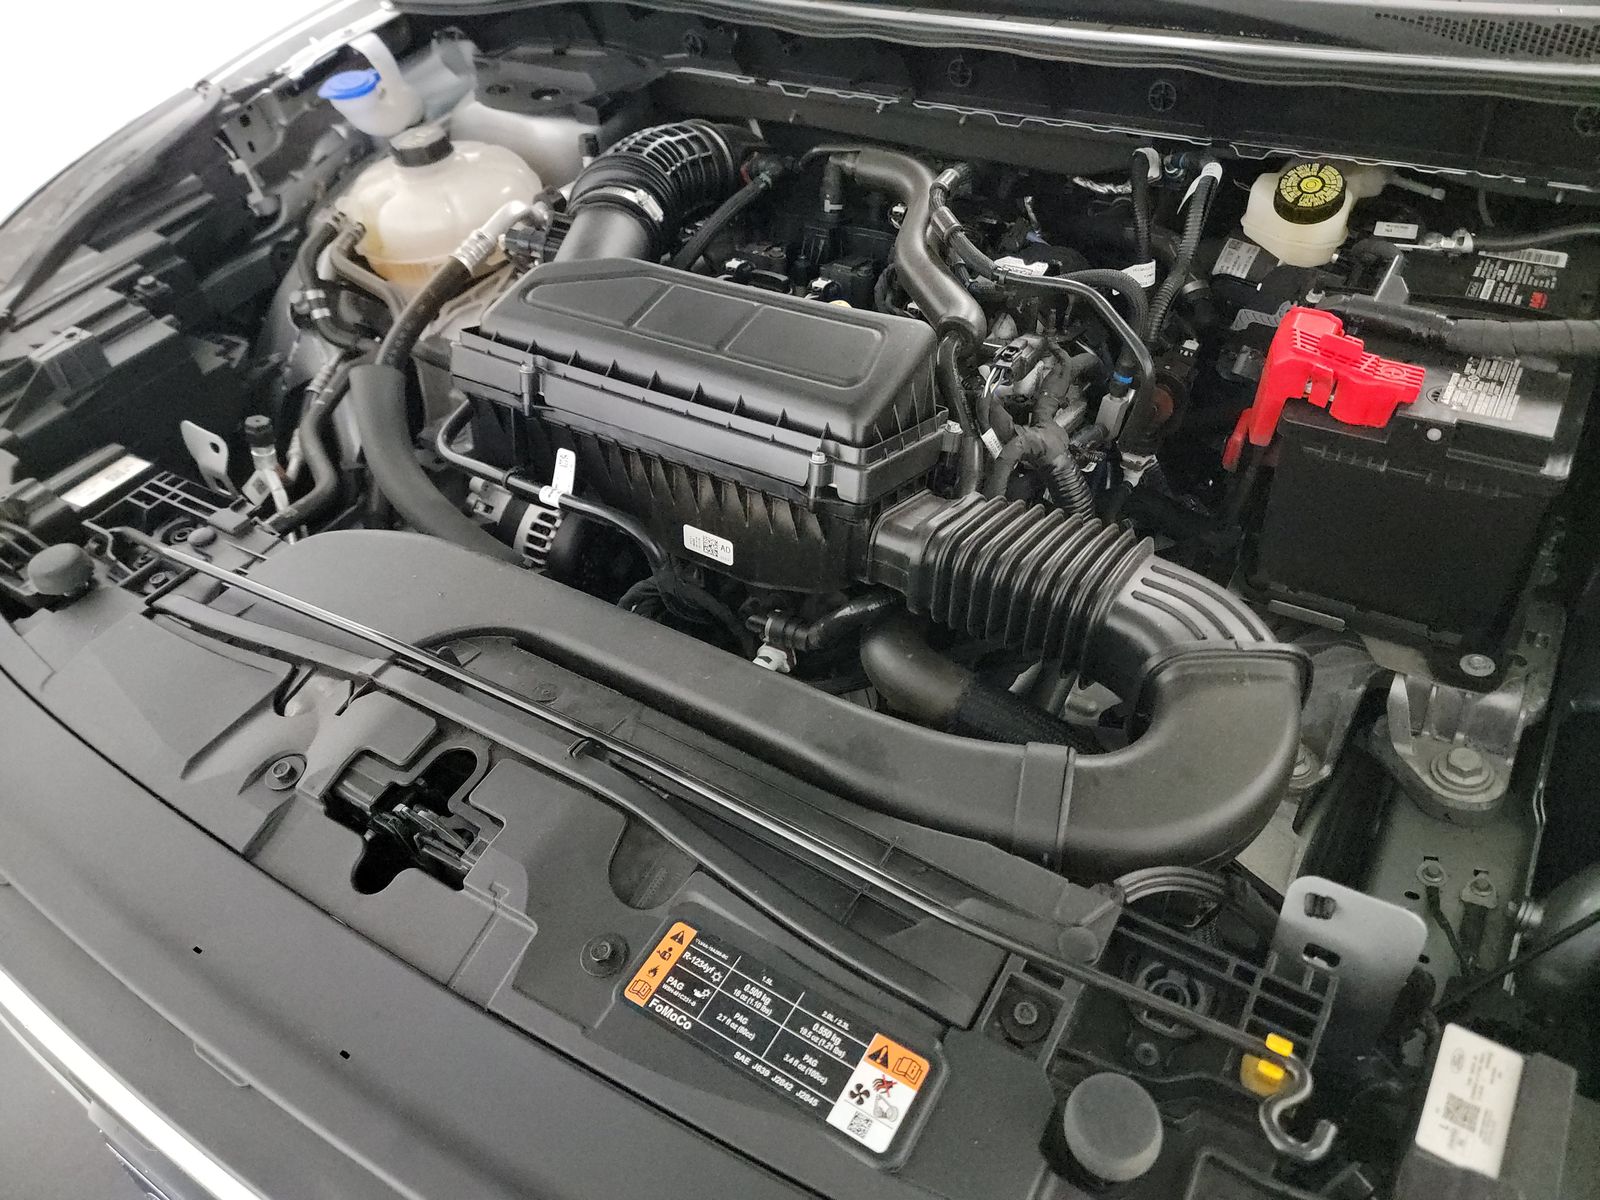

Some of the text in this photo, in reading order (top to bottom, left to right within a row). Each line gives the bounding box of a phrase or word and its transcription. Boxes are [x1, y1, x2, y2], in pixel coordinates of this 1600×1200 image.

[682, 951, 716, 974] R-1234yf
[666, 976, 684, 990] PAG
[739, 993, 748, 1001] oz
[761, 993, 772, 1006] kg
[649, 998, 692, 1030] FoMoCo
[734, 1012, 749, 1024] PAG
[730, 1022, 739, 1030] oz
[831, 1032, 841, 1046] kg
[733, 1052, 751, 1066] SAE
[802, 1054, 819, 1067] PAG
[797, 1063, 807, 1072] oz
